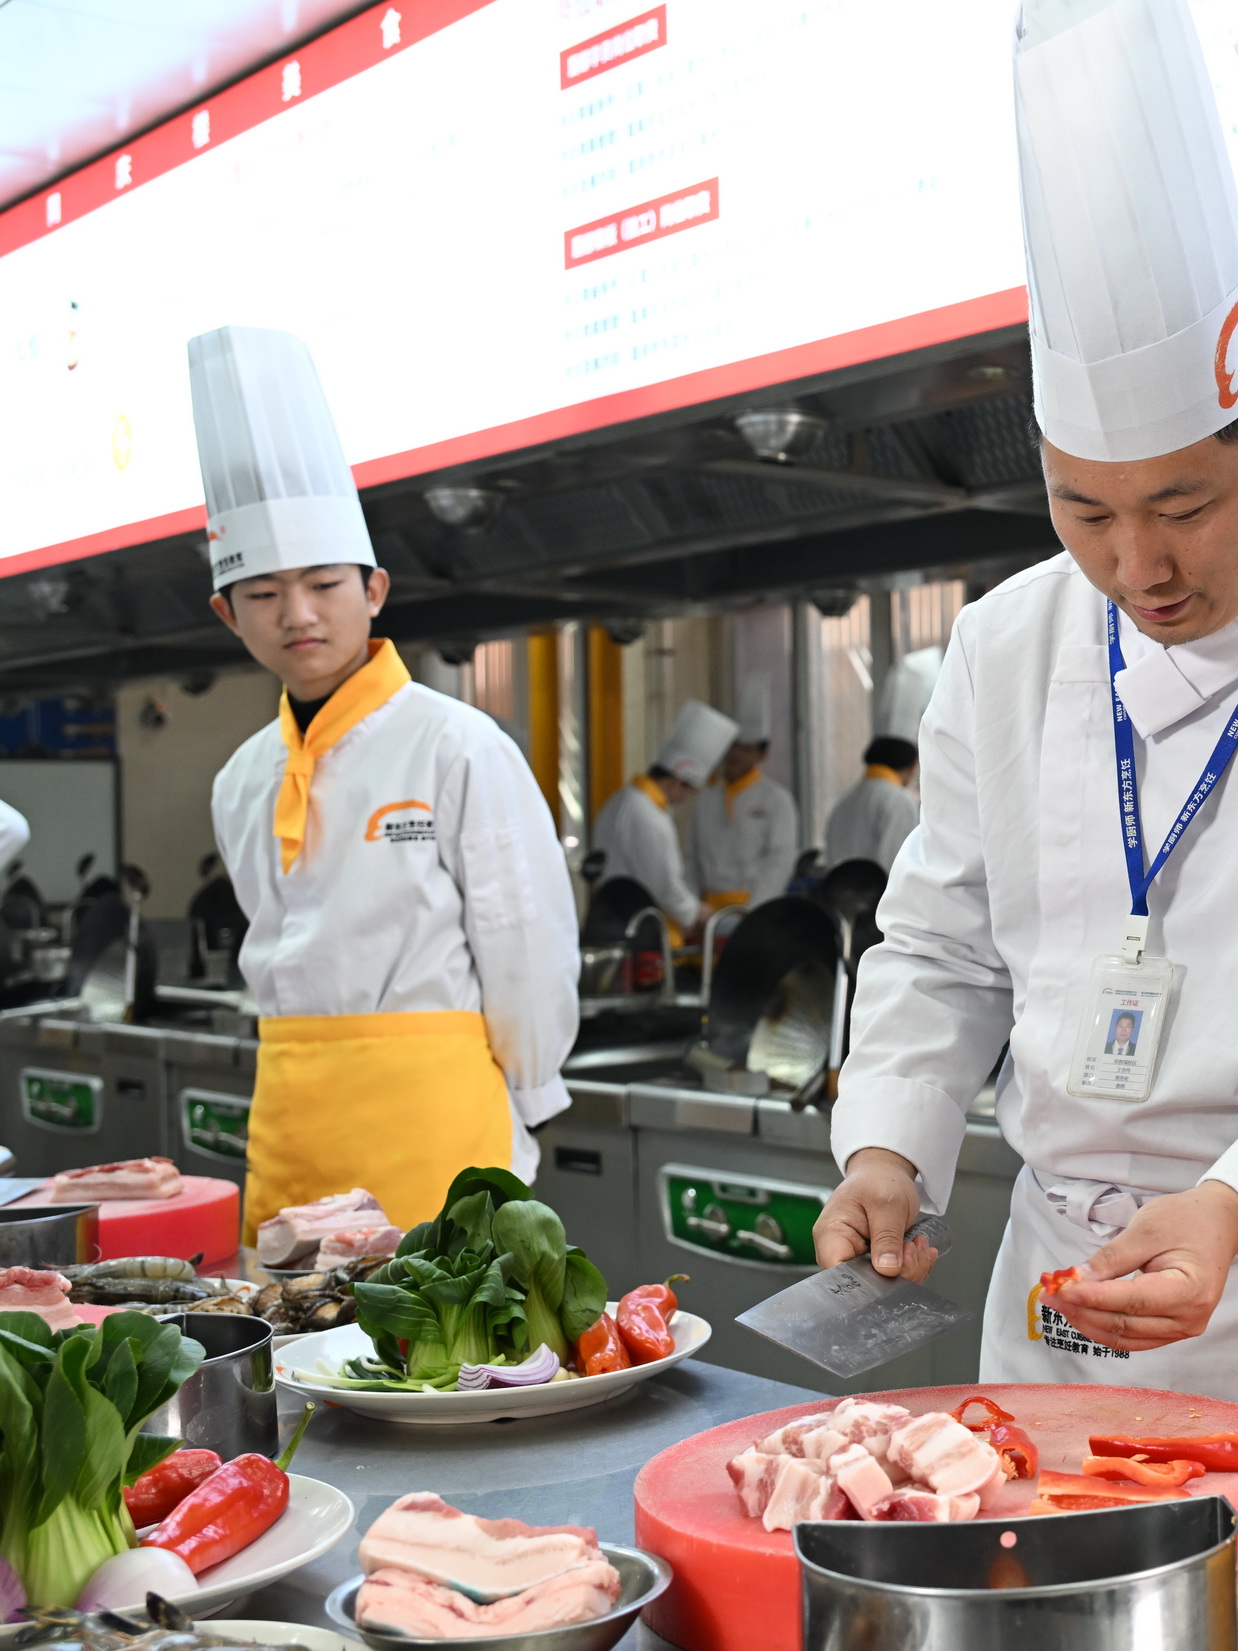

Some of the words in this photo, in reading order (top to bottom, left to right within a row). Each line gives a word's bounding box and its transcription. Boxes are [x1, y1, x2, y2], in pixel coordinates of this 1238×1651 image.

[1120, 758, 1135, 813] 新东方烹饪
[1162, 822, 1183, 854] 学厨师
[1180, 771, 1217, 822] 新东方烹饪
[1124, 814, 1138, 848] 学厨师
[1120, 999, 1140, 1007] 工作证
[1041, 1304, 1072, 1328] 新东
[1042, 1324, 1053, 1334] NEW
[1056, 1328, 1070, 1338] EAST
[1044, 1335, 1089, 1355] 专注烹饪教育
